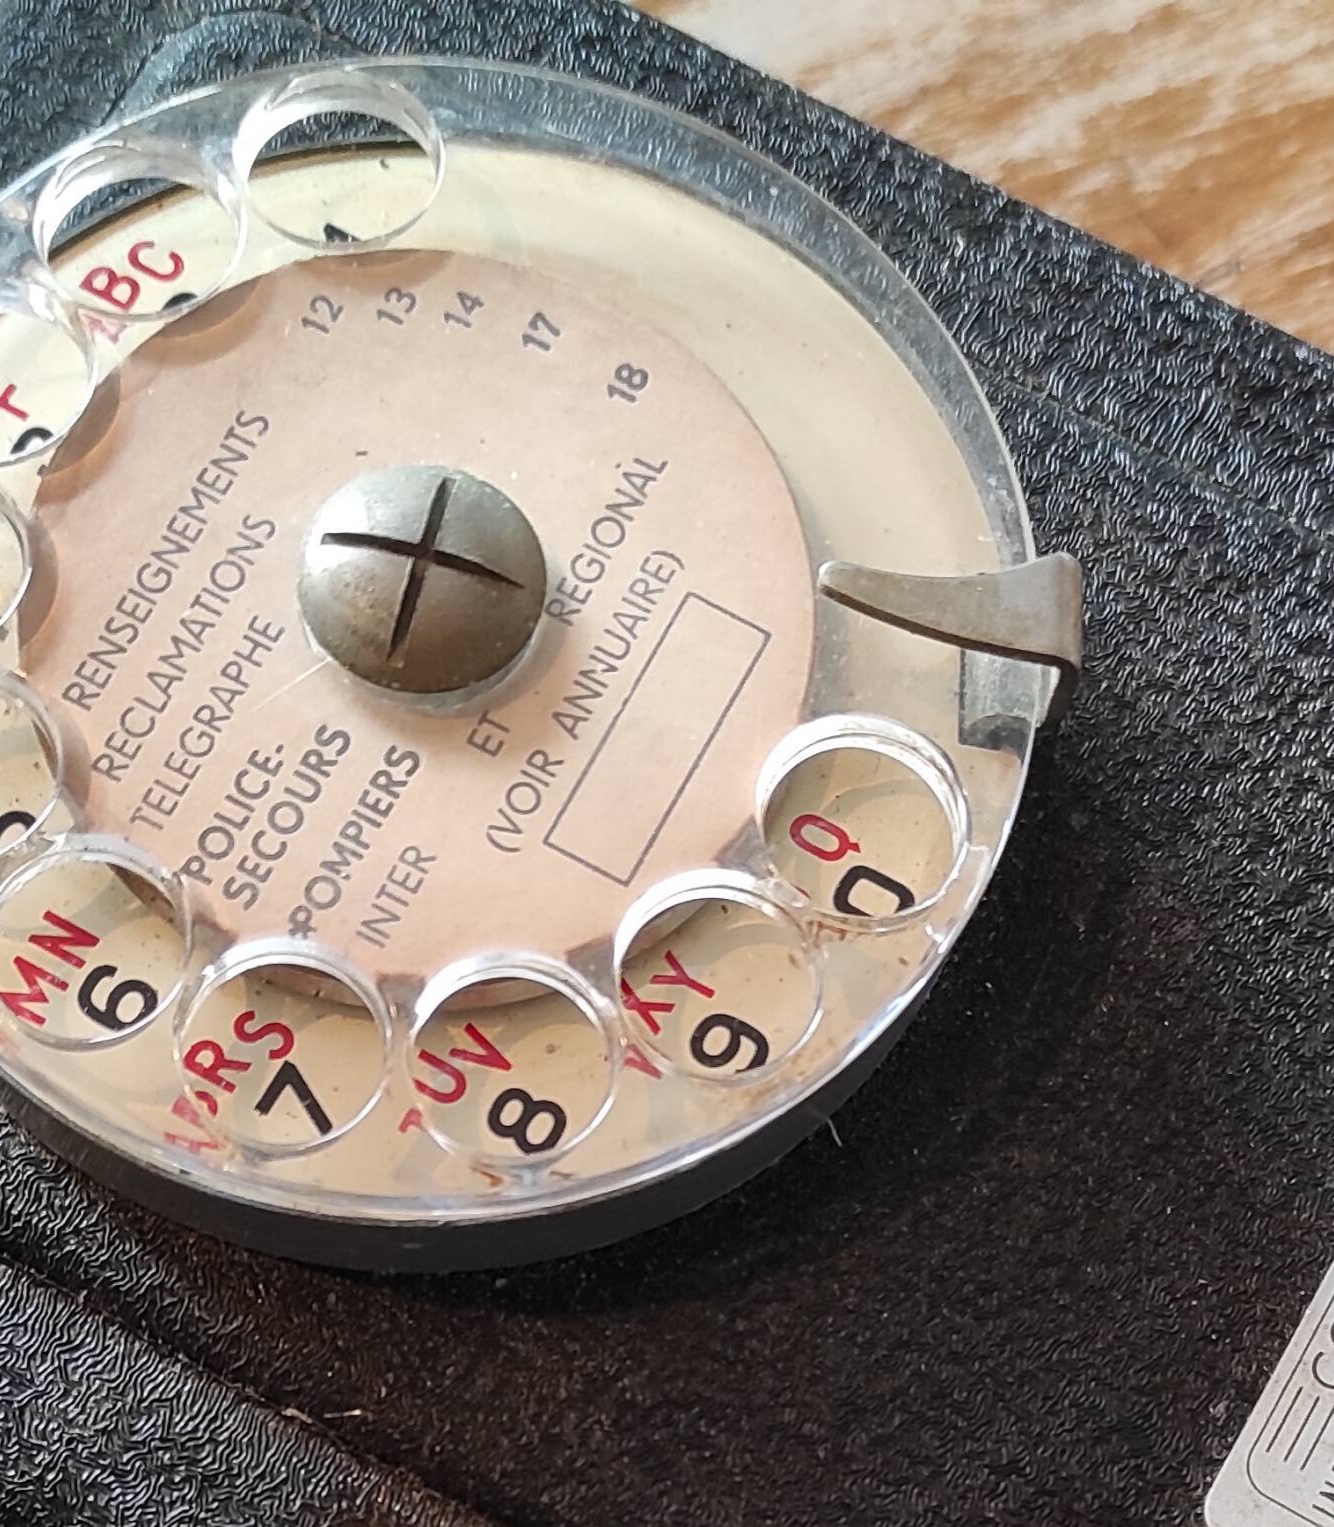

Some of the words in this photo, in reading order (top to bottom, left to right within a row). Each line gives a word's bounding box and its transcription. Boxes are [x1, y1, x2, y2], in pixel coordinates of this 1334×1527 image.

[62, 409, 270, 711] RENSEIGNEMENTS
[301, 294, 344, 333] 12
[91, 513, 276, 783] RECLAMATIONS
[376, 286, 417, 326] 13
[607, 362, 649, 403] 18
[130, 614, 285, 830] TELEGRAPHE
[443, 290, 485, 328] 14
[222, 724, 351, 912] SECOURS
[522, 311, 561, 351] 17
[356, 845, 437, 949] INTER
[466, 709, 510, 757] ET
[544, 456, 668, 626] REGIONAL
[485, 748, 565, 853] (VOIR
[552, 549, 685, 740] ANNUAIRE)
[78, 965, 158, 1031] 6
[254, 1060, 333, 1135] 7
[488, 1088, 567, 1155] 8
[689, 1013, 769, 1074] 9
